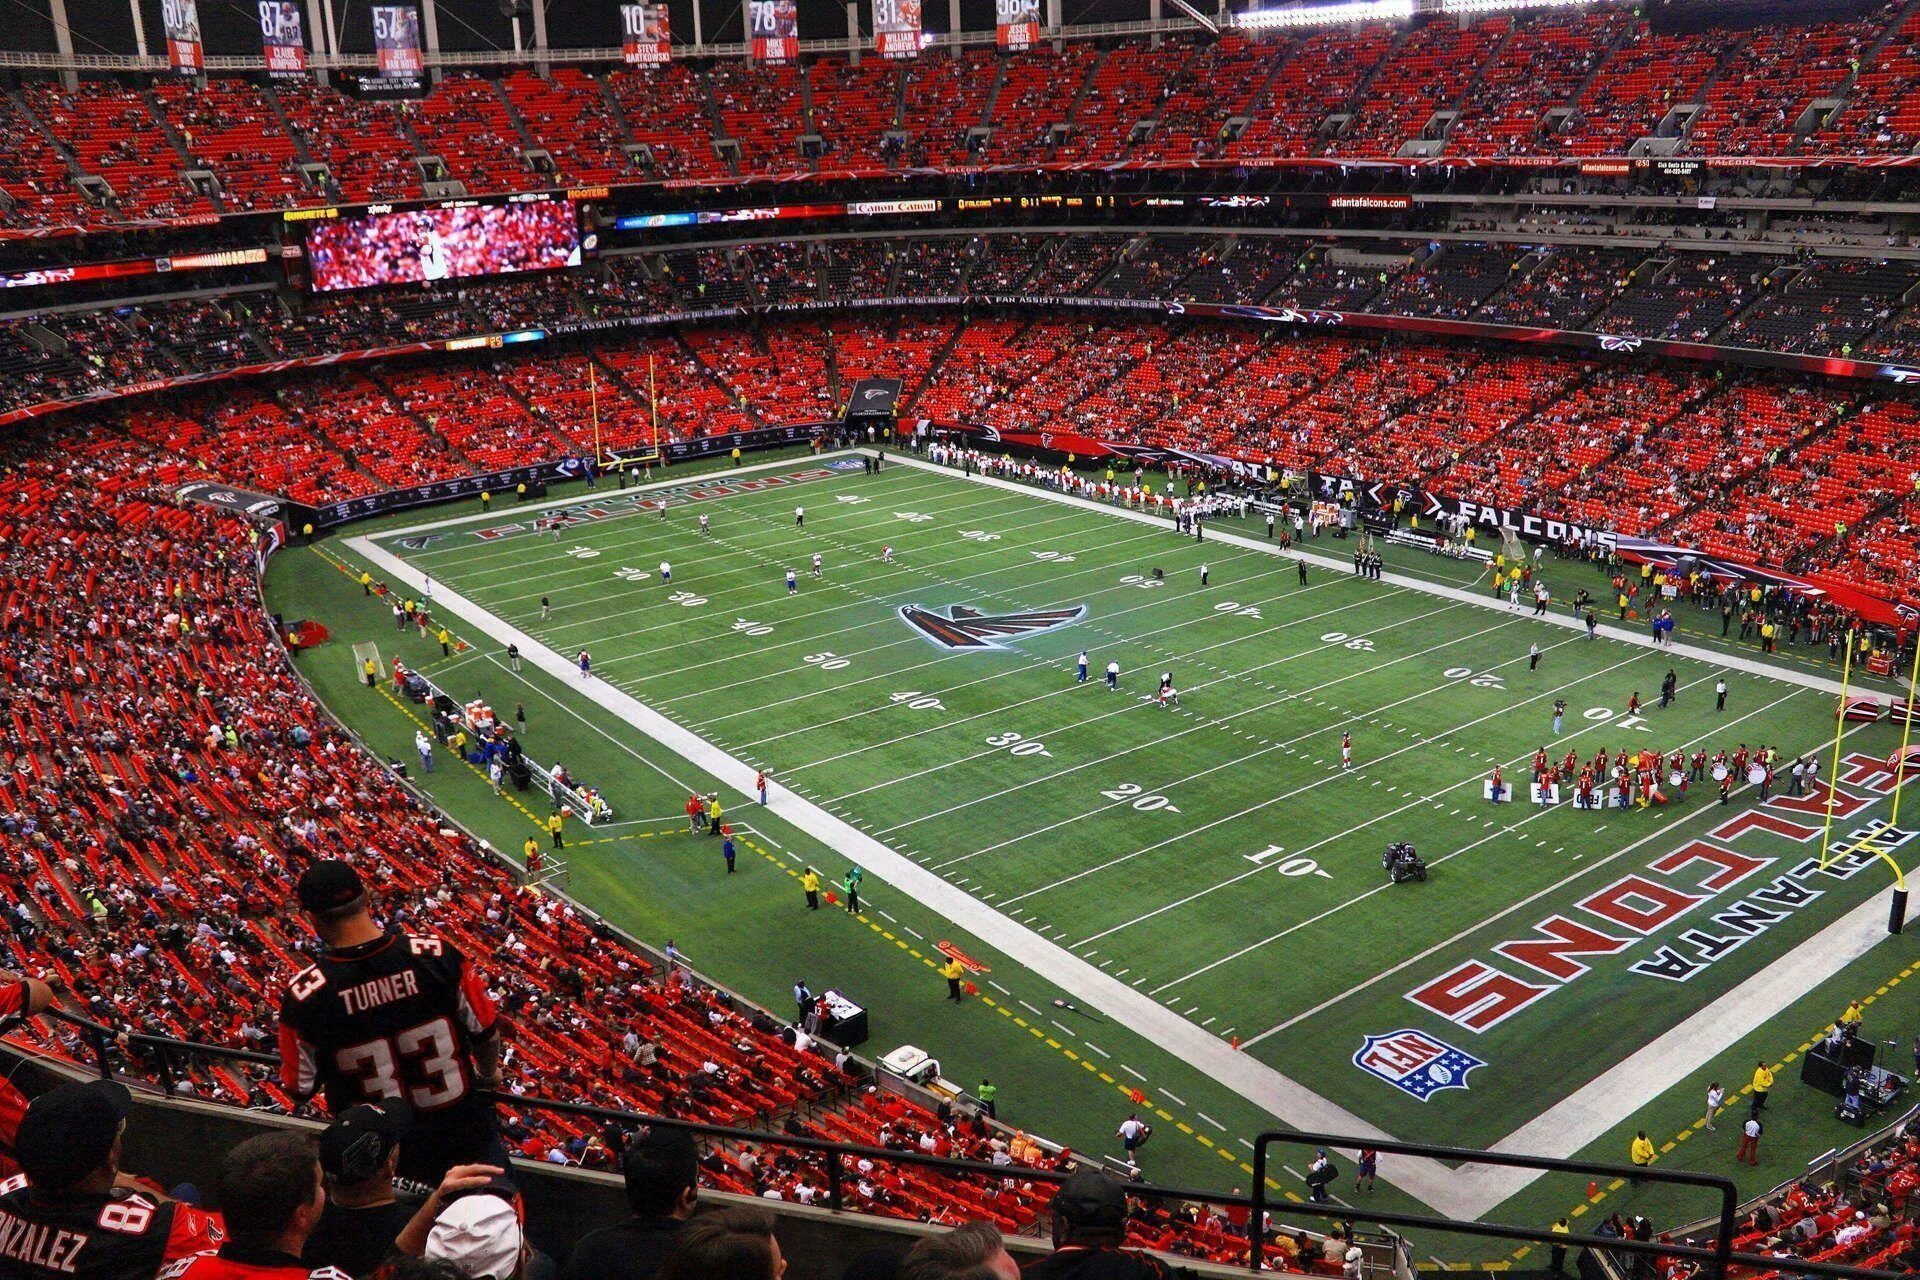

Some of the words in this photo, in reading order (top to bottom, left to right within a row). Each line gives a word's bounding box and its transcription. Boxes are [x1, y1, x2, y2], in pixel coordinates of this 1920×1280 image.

[259, 1, 281, 37] 87
[622, 5, 645, 35] 10
[750, 2, 776, 31] 78
[877, 0, 897, 25] 31
[372, 7, 397, 39] 57
[1008, 24, 1028, 34] JESSIE
[766, 38, 784, 49] MIKE
[885, 33, 914, 42] WILLIAM
[1007, 34, 1030, 43] TUGGLE
[273, 47, 296, 58] CLAUDE
[637, 43, 658, 53] STEVE
[766, 48, 785, 58] KENN
[884, 41, 916, 51] ANDREWS
[270, 58, 301, 70] HUMPHREY
[625, 53, 670, 62] BARTKOWSKI
[567, 188, 609, 199] HOOTERS
[858, 202, 894, 214] Canon
[897, 201, 934, 211] Canon
[964, 200, 992, 208] FALCONS
[1331, 197, 1407, 208] atlantafalcons.com
[172, 216, 219, 225] FALCONS
[122, 382, 165, 395] FALCONS
[1459, 501, 1617, 552] FALCONS
[612, 567, 651, 580] 20
[1120, 575, 1164, 589] 50
[668, 591, 708, 606] 30
[1213, 602, 1262, 616] 40
[731, 617, 774, 636] 40
[1320, 632, 1374, 650] 30
[803, 652, 851, 670] 50
[1443, 667, 1504, 684] 20
[889, 691, 940, 710] 40
[1583, 707, 1647, 728] 10
[985, 732, 1045, 756] 30
[1100, 783, 1170, 811] 20
[1242, 844, 1318, 876] 10
[1402, 752, 1920, 1035] FALCONS
[1627, 818, 1920, 982] ATLANTA
[338, 969, 420, 1015] TURNER
[336, 1017, 465, 1108] 33
[1364, 1034, 1443, 1075] NFL
